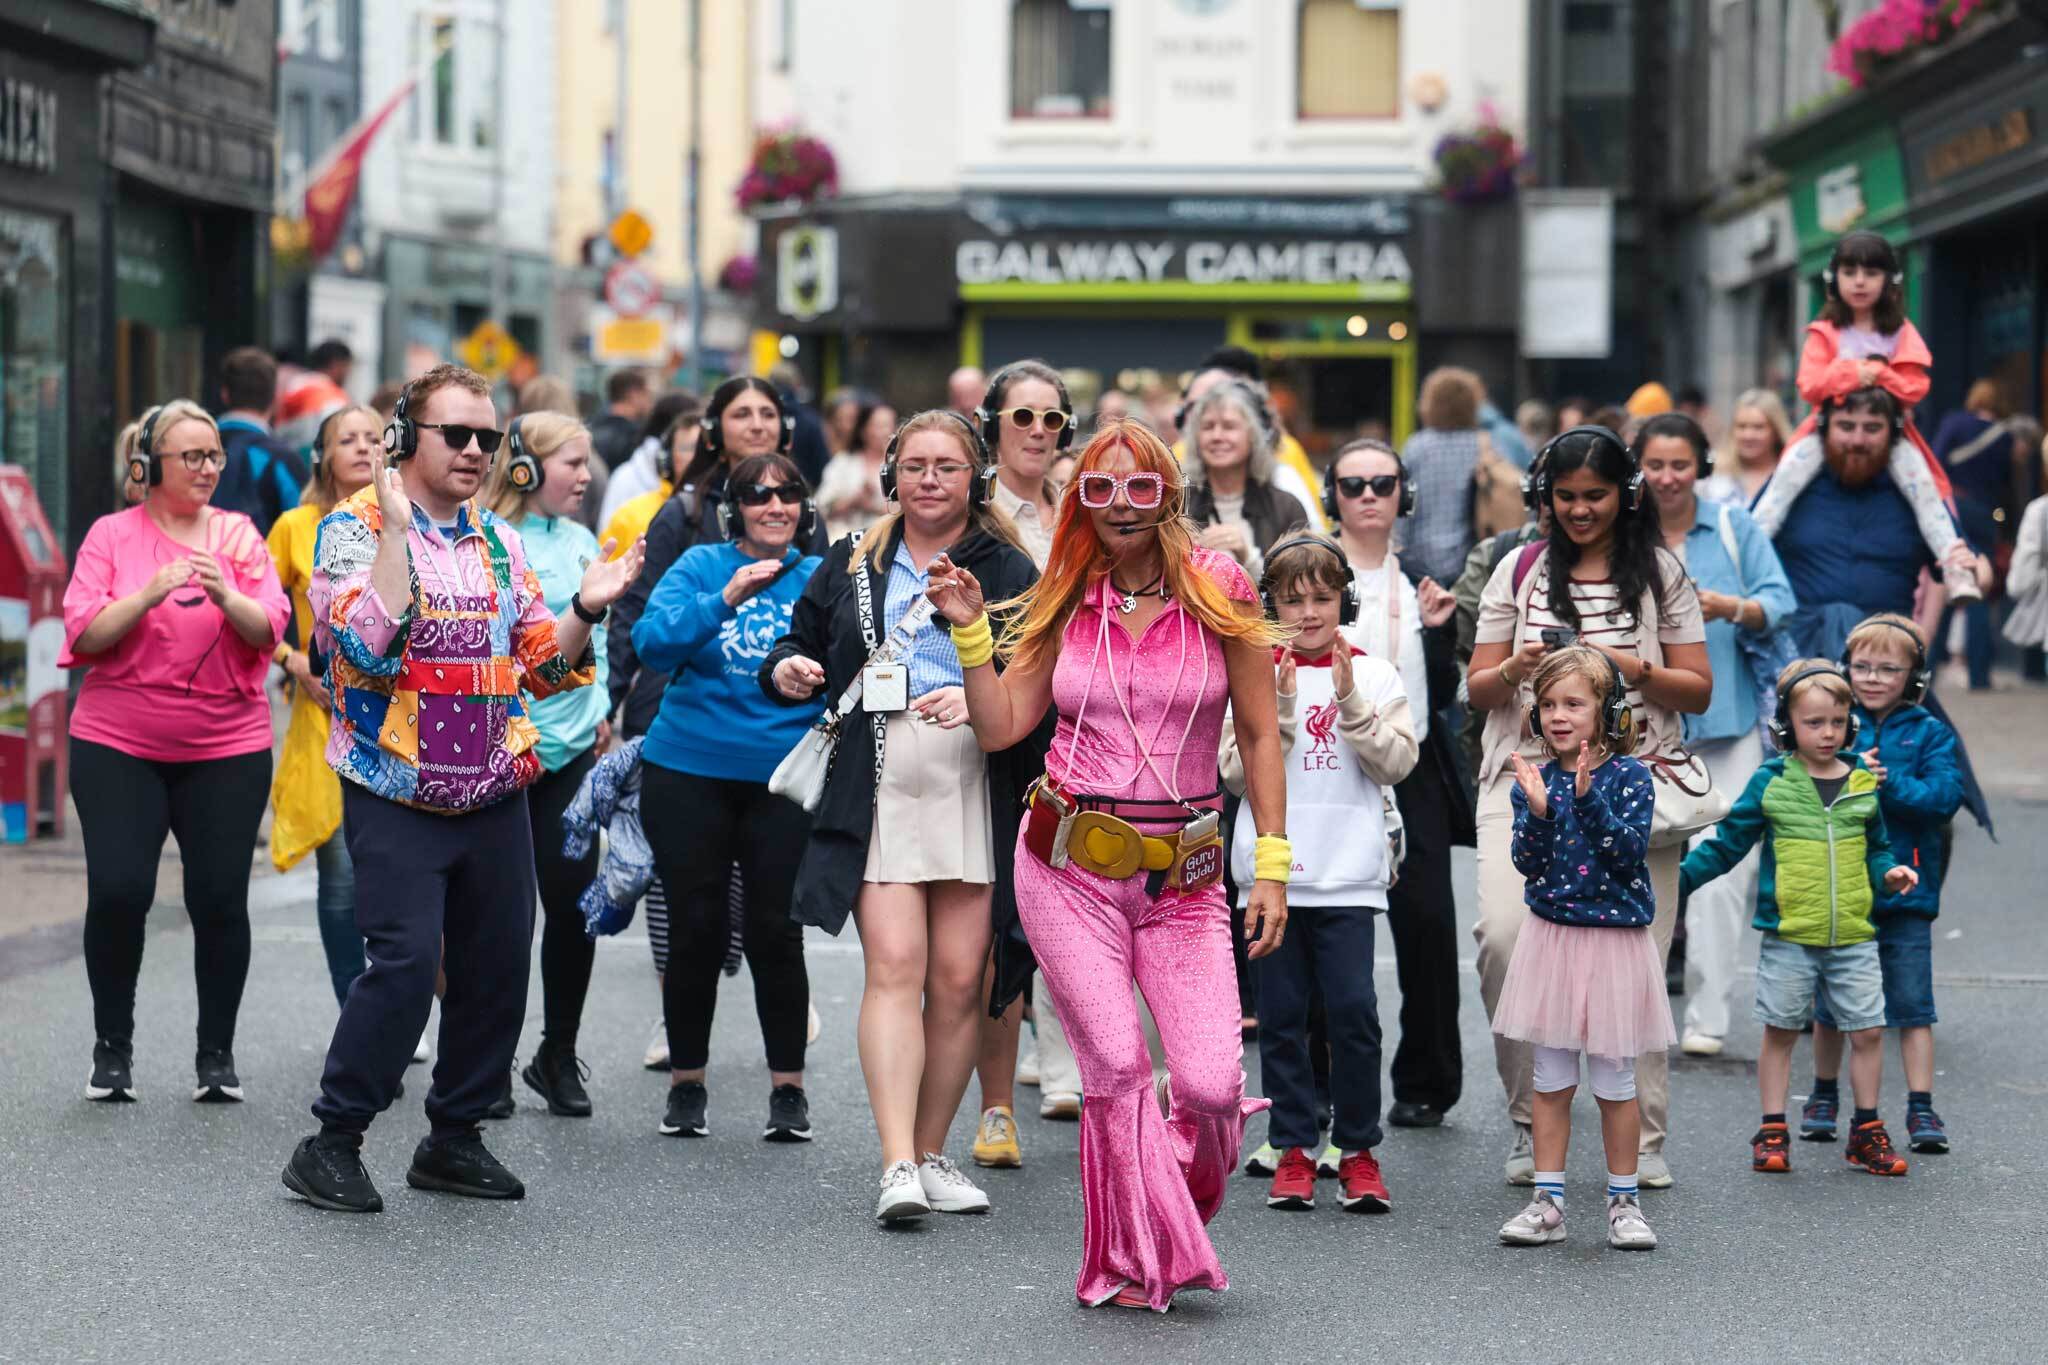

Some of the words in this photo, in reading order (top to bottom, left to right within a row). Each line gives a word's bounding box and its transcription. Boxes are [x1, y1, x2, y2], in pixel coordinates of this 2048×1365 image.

[957, 241, 1172, 283] GALWAY
[1185, 241, 1410, 283] CAMERA
[1303, 755, 1342, 772] L.F.C.
